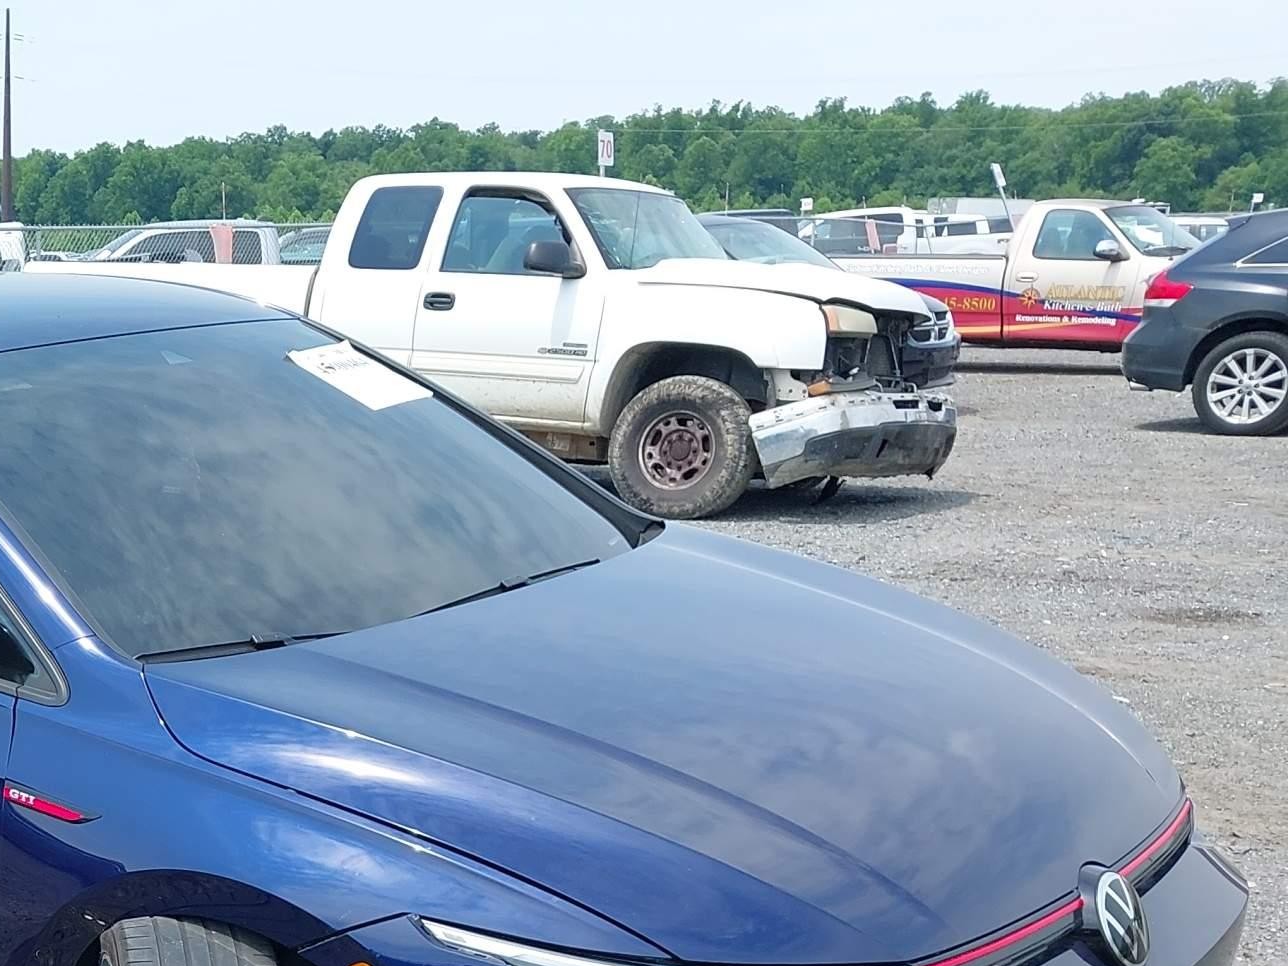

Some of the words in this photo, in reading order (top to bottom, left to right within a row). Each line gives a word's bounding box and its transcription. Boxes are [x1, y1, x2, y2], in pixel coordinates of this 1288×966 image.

[599, 139, 612, 158] 70
[1044, 300, 1083, 311] Kitchen
[1096, 301, 1122, 313] Bath
[1015, 314, 1060, 323] Renovations
[1062, 315, 1069, 323] &
[1071, 316, 1117, 326] Remodeling
[9, 788, 36, 805] GTI
